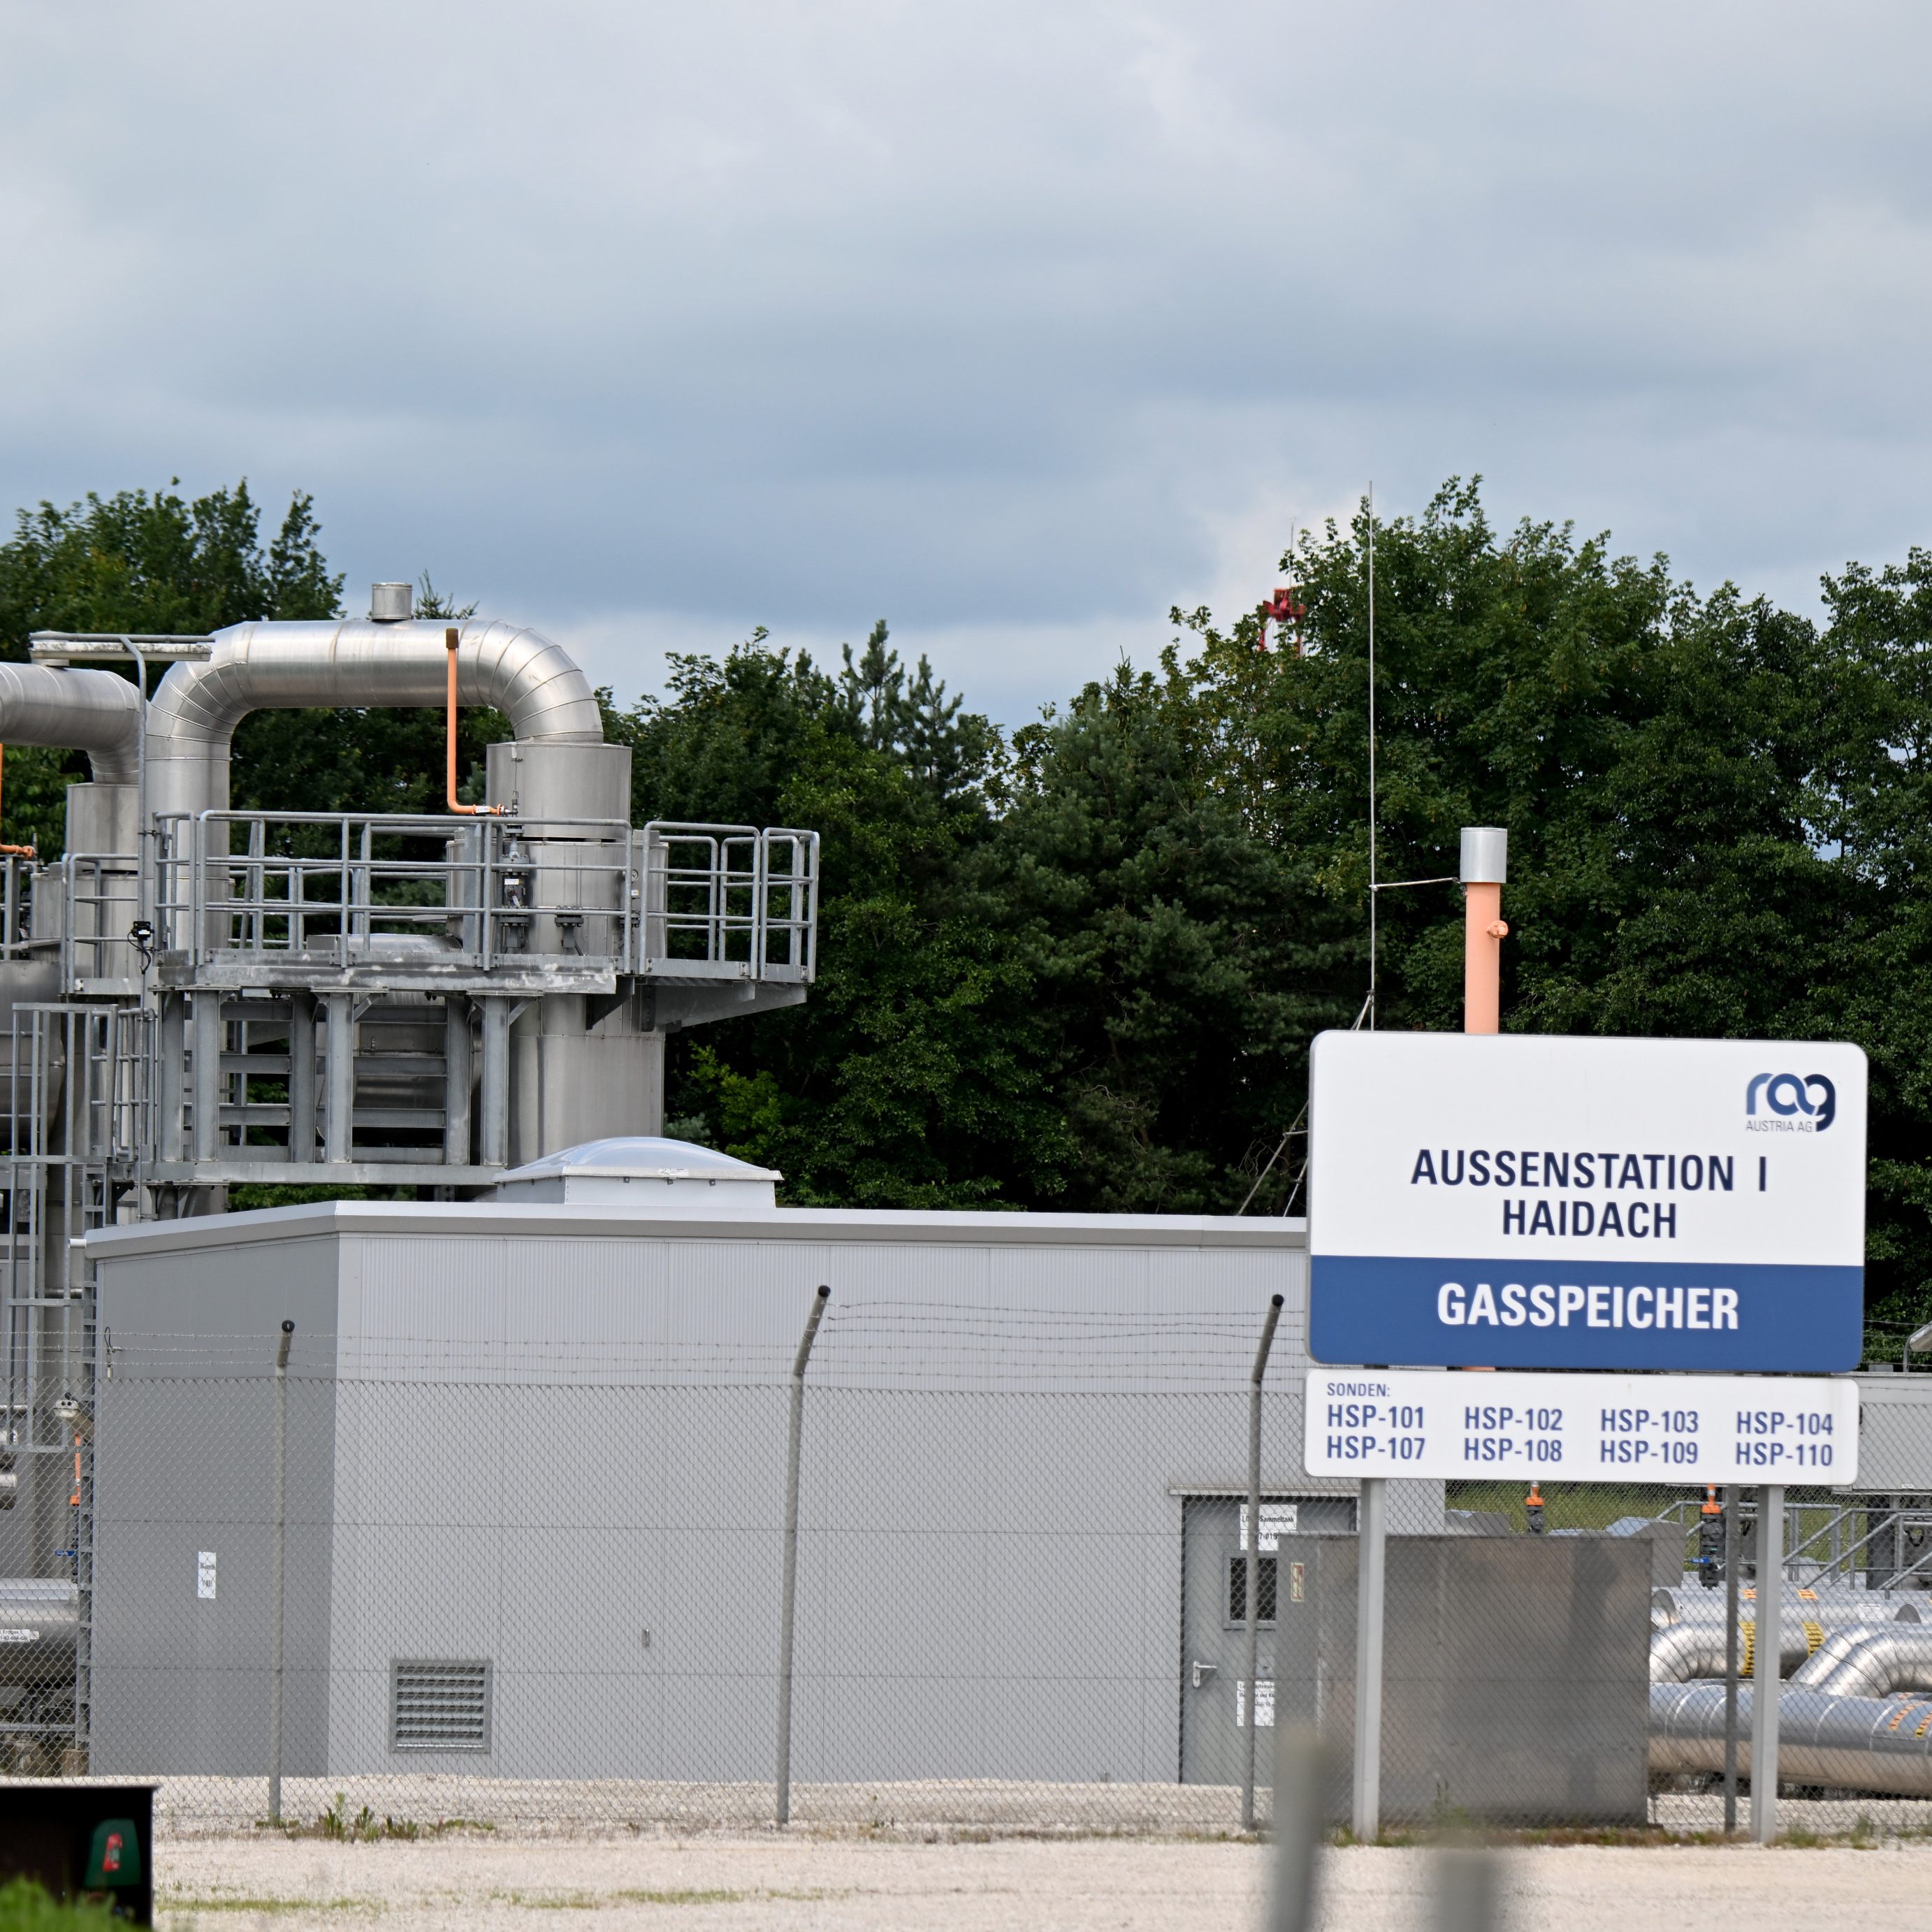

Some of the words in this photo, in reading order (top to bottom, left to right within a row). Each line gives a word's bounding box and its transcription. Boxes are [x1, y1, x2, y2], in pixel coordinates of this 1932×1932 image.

[1746, 1073, 1836, 1133] rag
[1745, 1120, 1794, 1132] AUSTRIA
[1797, 1121, 1813, 1133] AG
[1411, 1149, 1734, 1192] AUSSENSTATION
[1759, 1156, 1766, 1192] I
[1503, 1199, 1676, 1238] HAIDACH
[1437, 1282, 1738, 1330] GASSPEICHER
[1327, 1382, 1390, 1397] SONDEN:
[1327, 1404, 1424, 1429] HSP-101
[1465, 1407, 1562, 1431] HSP-102
[1601, 1409, 1699, 1433] HSP-103
[1736, 1411, 1833, 1436] HSP-104
[1327, 1435, 1425, 1460] HSP-107
[1464, 1437, 1562, 1462] HSP-108
[1600, 1439, 1698, 1465] HSP-109
[1736, 1441, 1833, 1467] HSP-110
